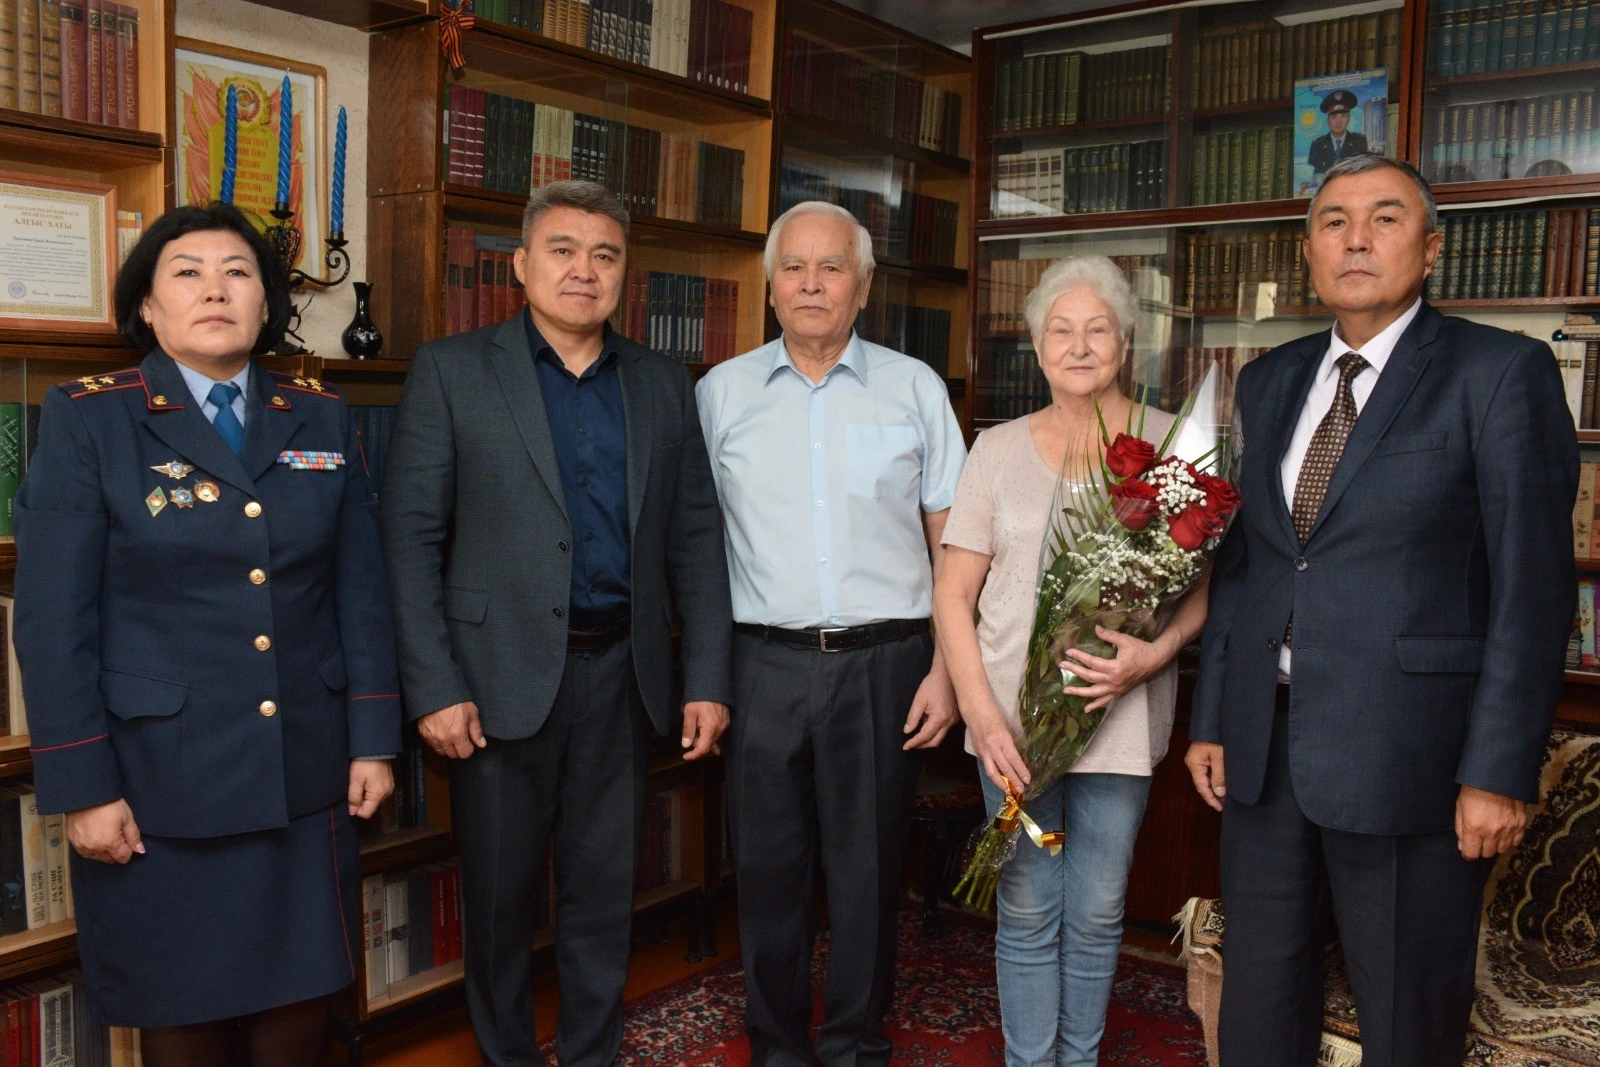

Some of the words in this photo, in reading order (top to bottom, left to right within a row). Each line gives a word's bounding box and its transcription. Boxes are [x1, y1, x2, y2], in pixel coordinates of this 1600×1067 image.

[92, 15, 99, 25] 2
[91, 34, 99, 65] ПОПОВ
[106, 37, 114, 66] ПОПОВ
[106, 67, 116, 114] ВЛАДИМИР
[126, 74, 135, 120] ВЛАДИМИР
[48, 221, 73, 230] ХАТЫ
